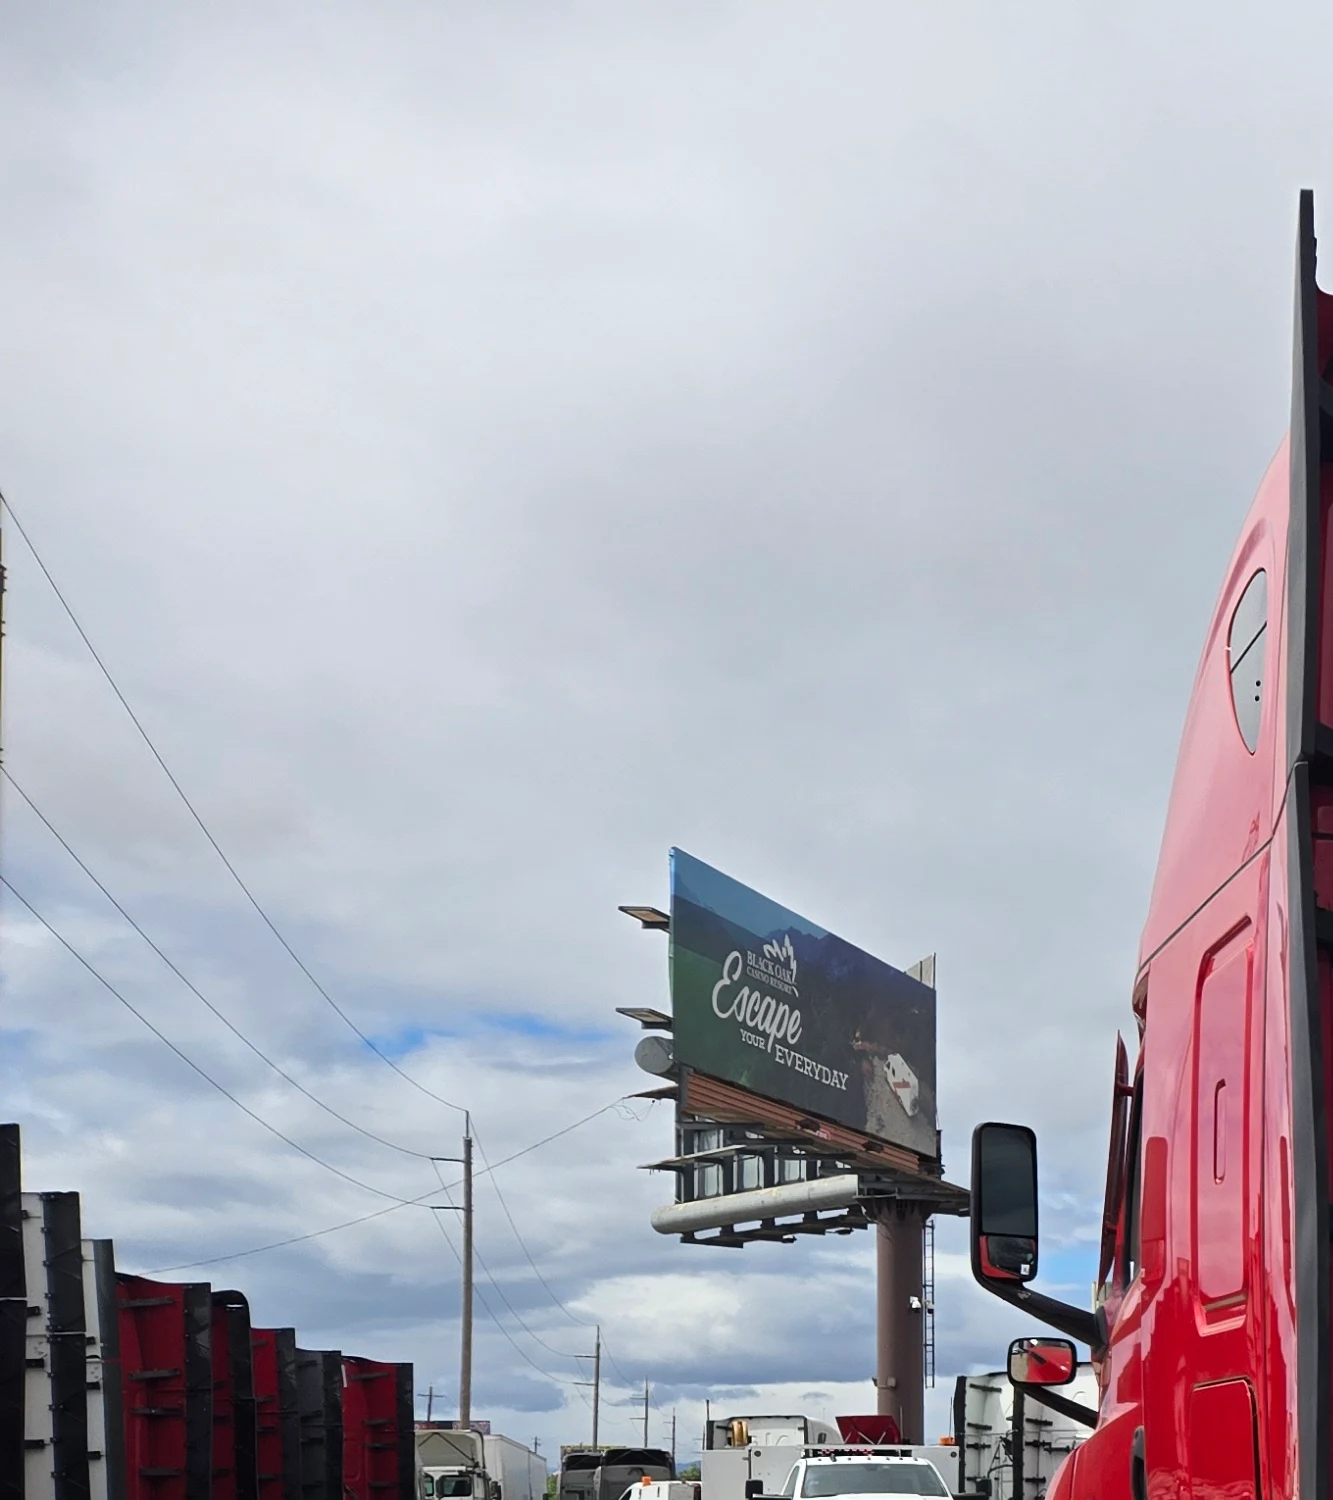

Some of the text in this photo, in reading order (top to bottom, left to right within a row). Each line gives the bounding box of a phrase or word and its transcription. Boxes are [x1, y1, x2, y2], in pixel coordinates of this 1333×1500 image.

[747, 950, 793, 985] BLACK OAK
[712, 951, 802, 1053] Escape
[739, 1027, 766, 1051] YOUR
[774, 1044, 849, 1092] EVERYDAY
